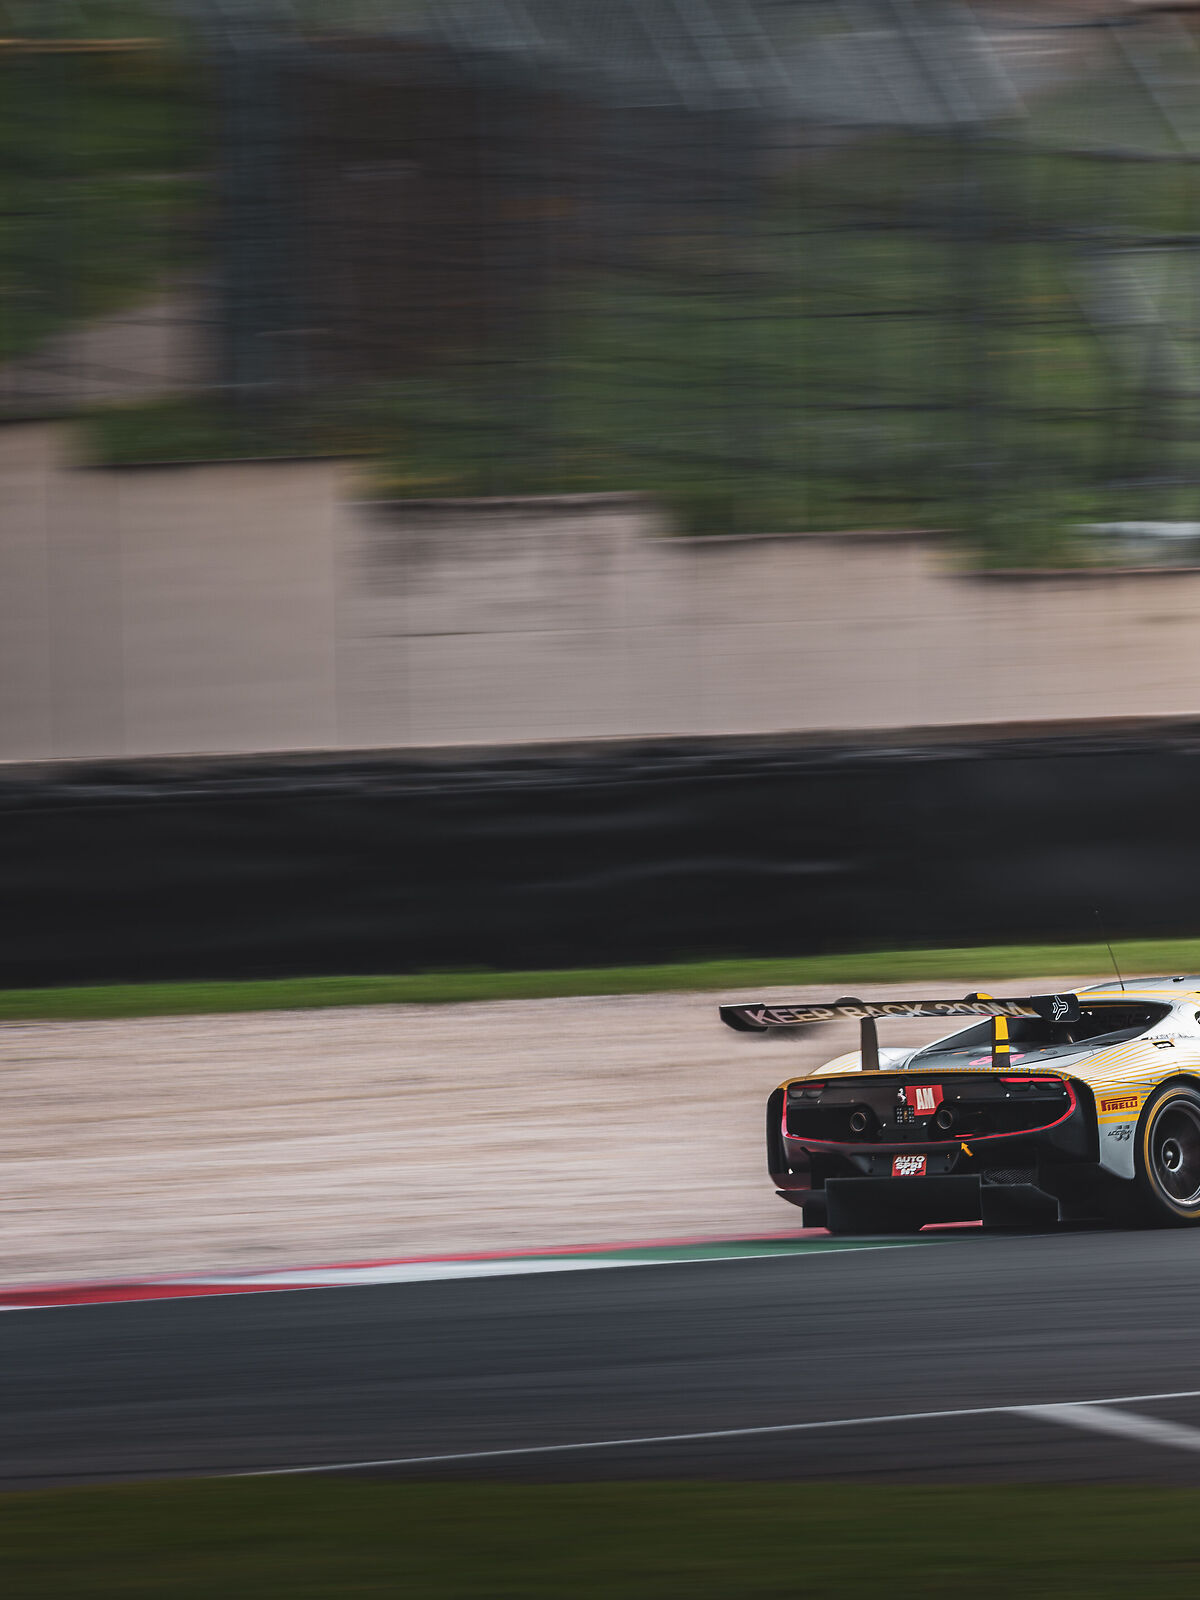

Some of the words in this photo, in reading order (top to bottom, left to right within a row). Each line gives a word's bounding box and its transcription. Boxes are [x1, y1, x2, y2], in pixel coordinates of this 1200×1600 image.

[744, 1007, 835, 1025] KEEP
[836, 1004, 939, 1018] BACK
[934, 1001, 1033, 1017] 200M
[915, 1087, 936, 1110] AM
[1100, 1096, 1138, 1112] PIRELLI
[895, 1155, 925, 1163] AUTO
